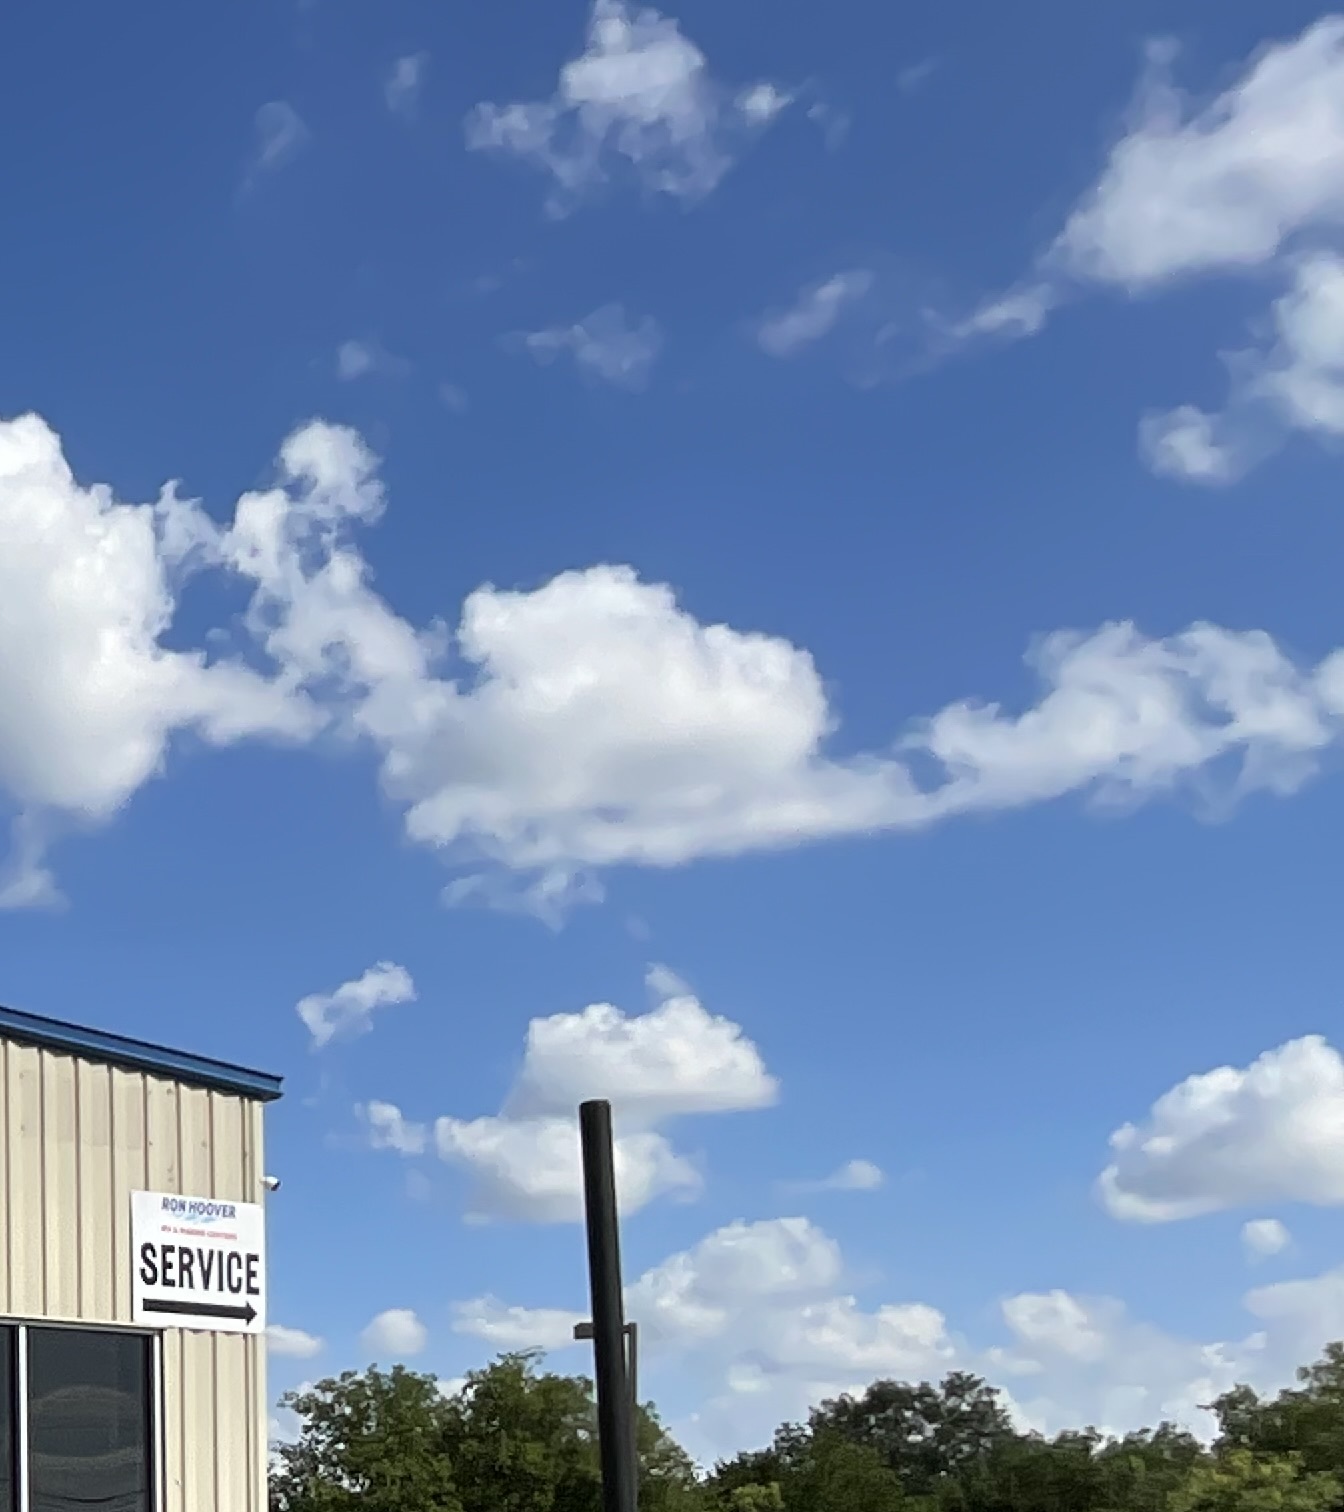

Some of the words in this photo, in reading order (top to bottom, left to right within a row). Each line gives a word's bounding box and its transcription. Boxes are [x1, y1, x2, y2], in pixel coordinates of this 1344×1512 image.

[161, 1197, 186, 1212] RON
[188, 1200, 236, 1218] HOOVER
[139, 1242, 260, 1295] SERVICE
